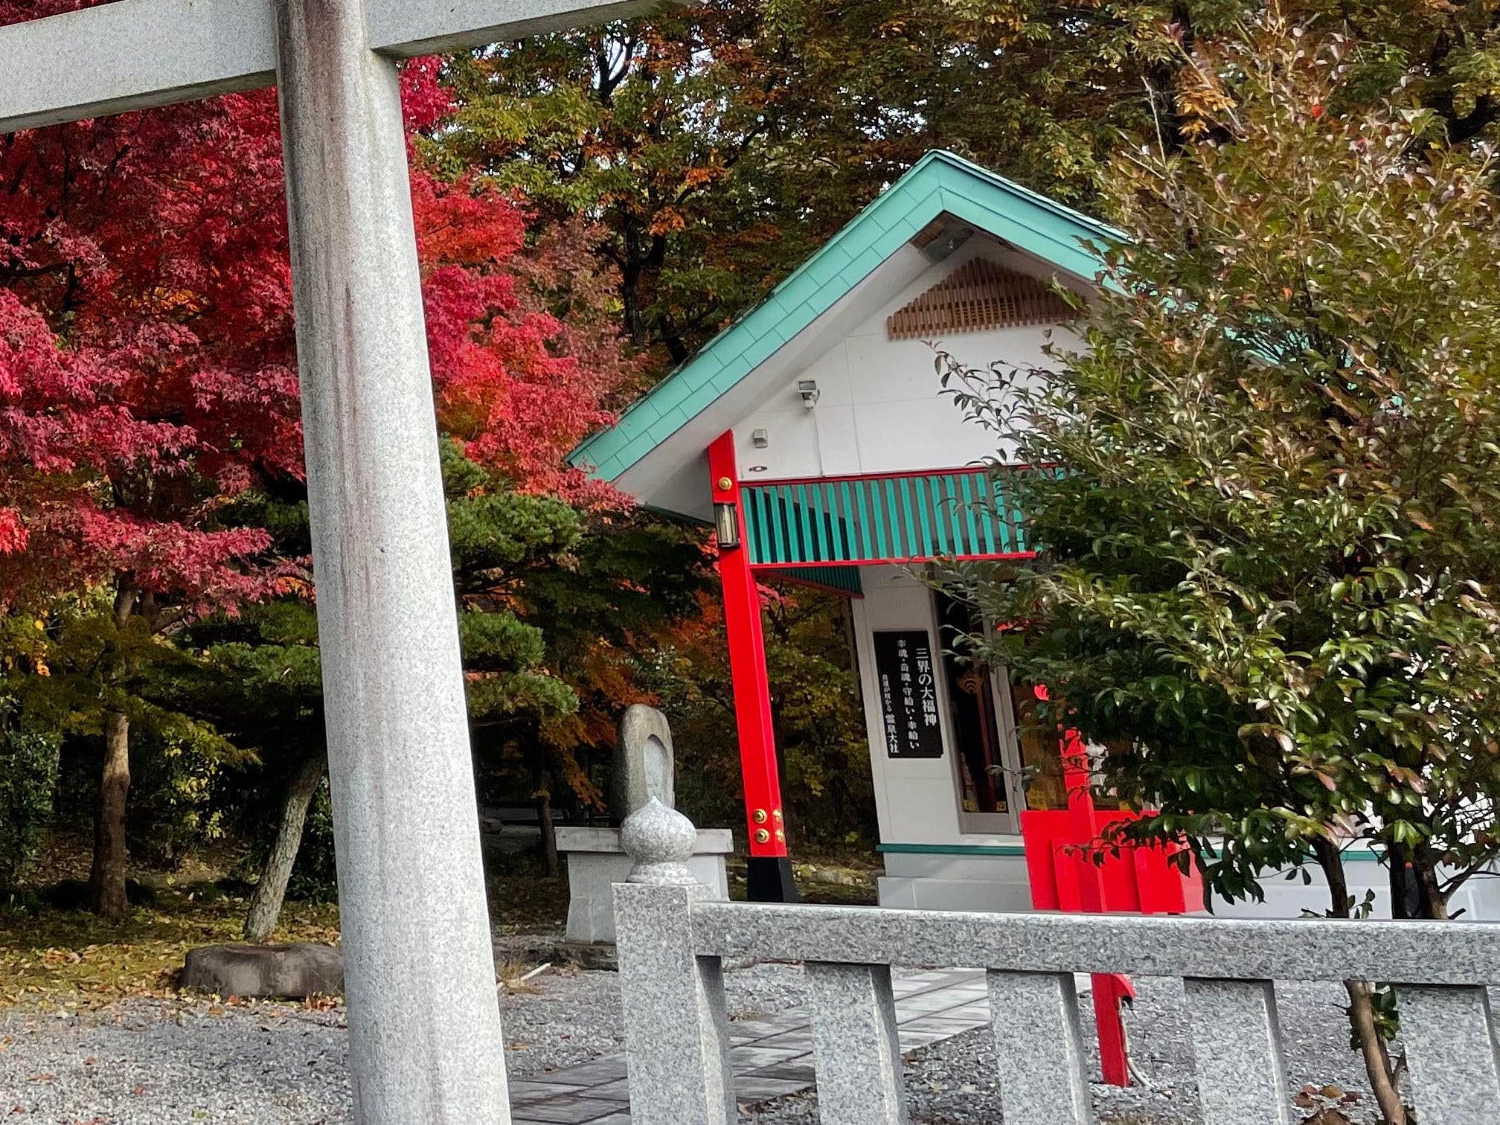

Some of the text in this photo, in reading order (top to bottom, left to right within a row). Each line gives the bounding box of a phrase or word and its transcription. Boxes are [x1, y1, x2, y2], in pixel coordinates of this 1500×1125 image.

[915, 647, 937, 727] 三界の大福神
